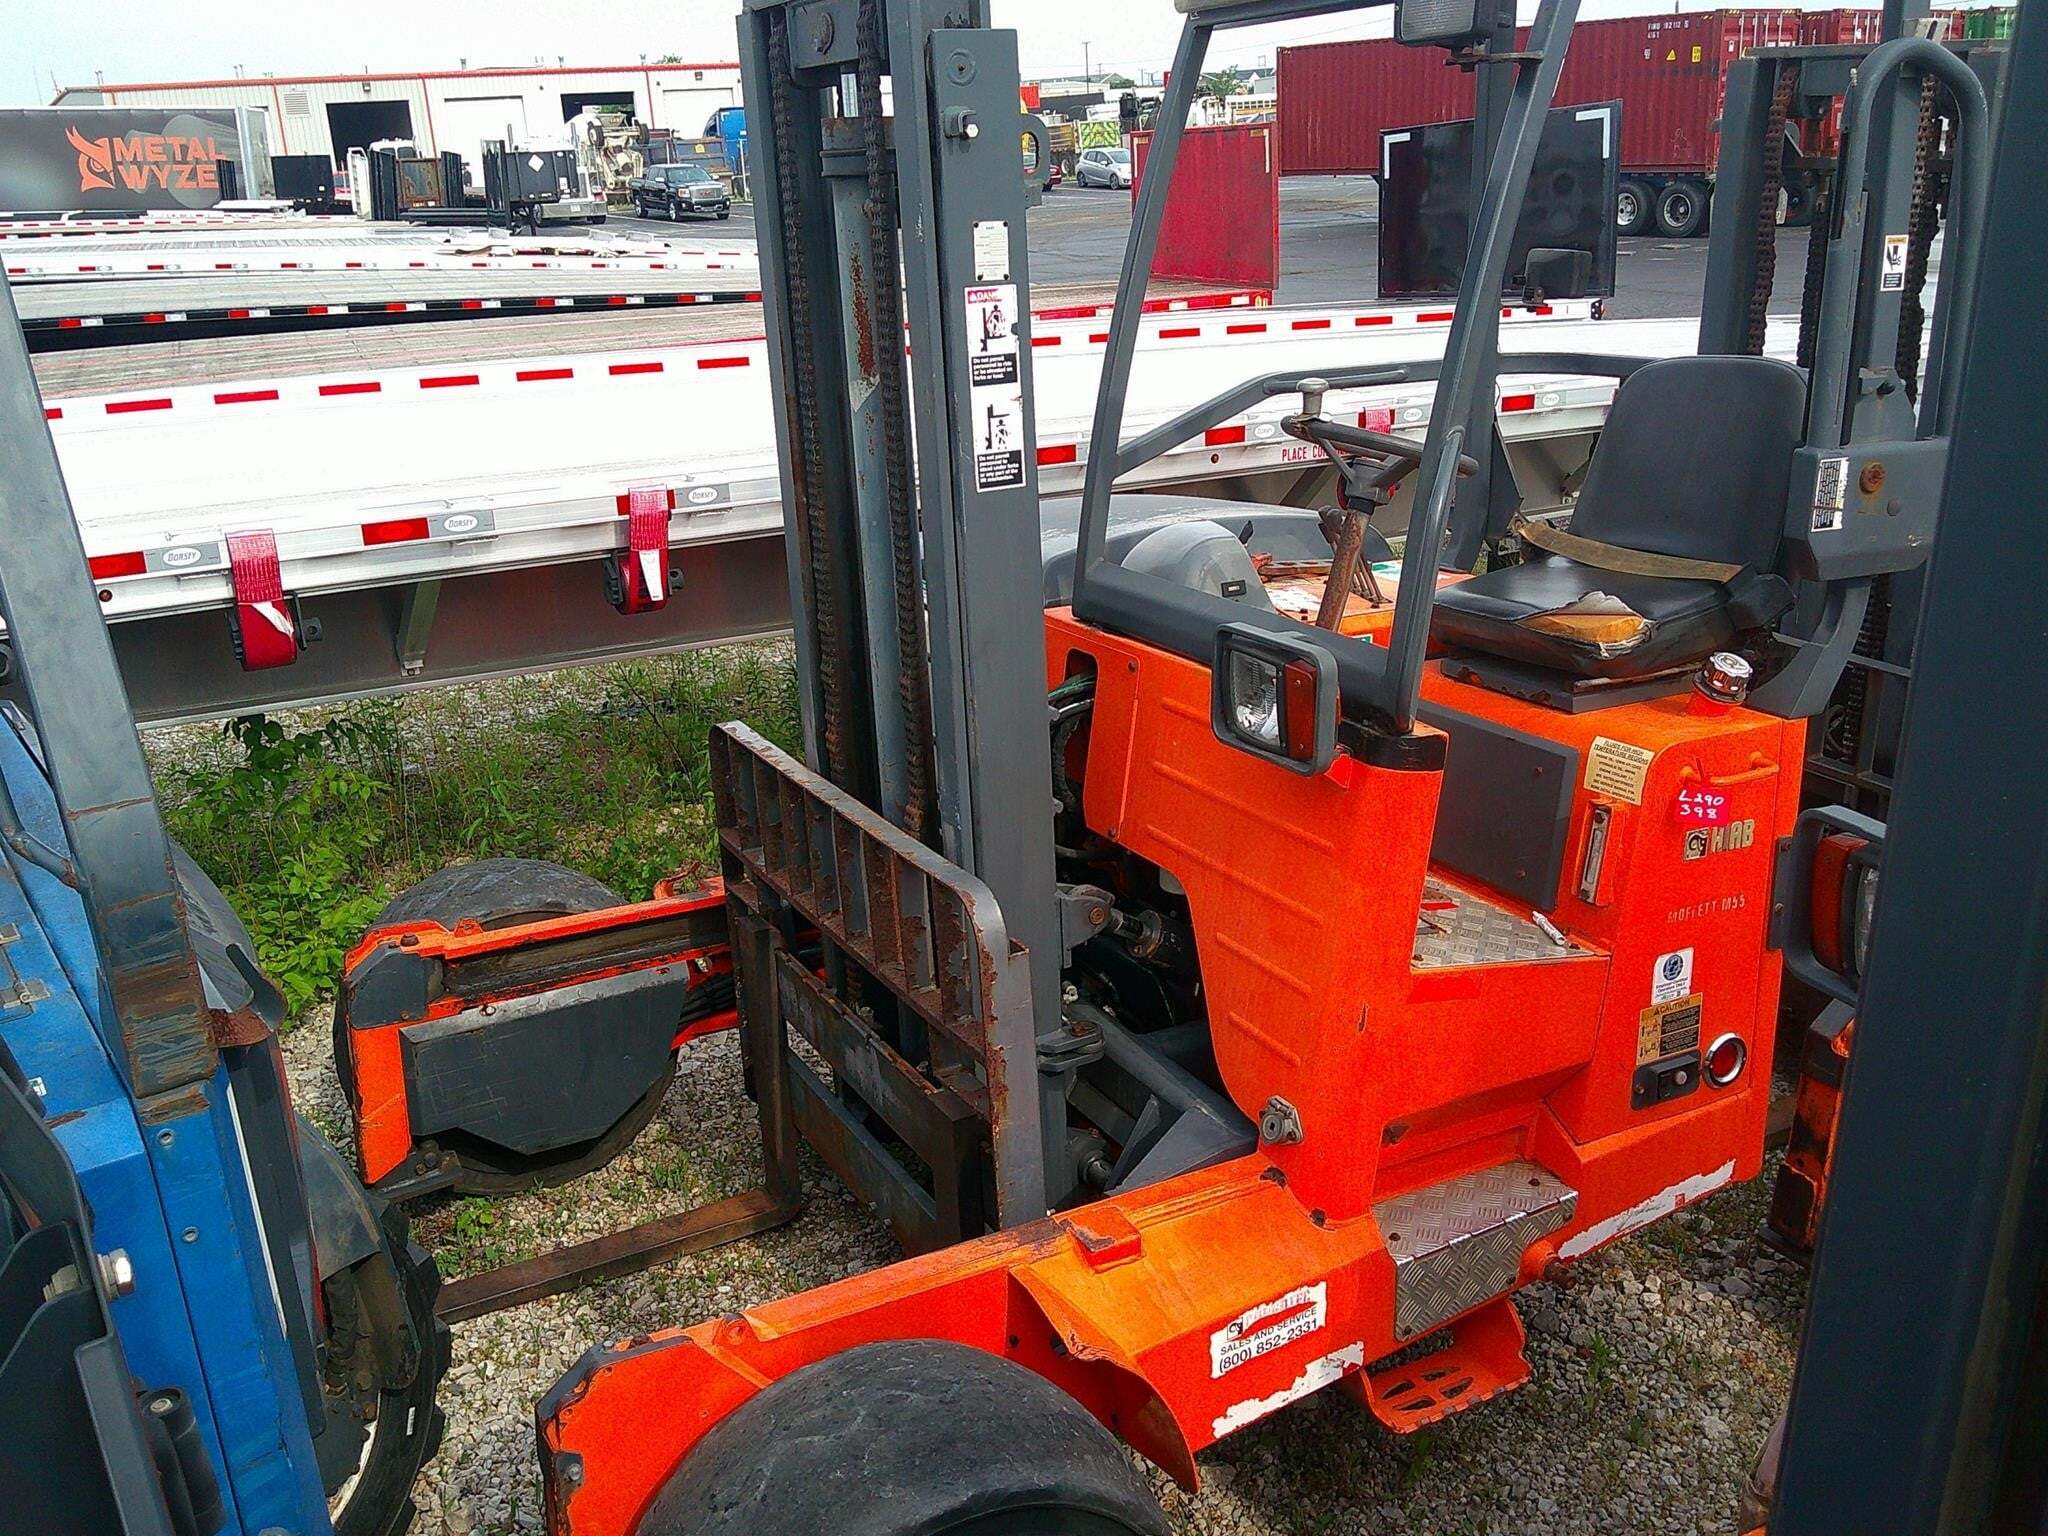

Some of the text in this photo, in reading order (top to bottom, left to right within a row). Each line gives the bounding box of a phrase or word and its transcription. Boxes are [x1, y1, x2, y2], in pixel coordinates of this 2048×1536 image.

[113, 137, 230, 162] METAL
[117, 164, 219, 189] WYZE
[1282, 446, 1307, 461] PLACE
[448, 519, 474, 528] DORSEY
[168, 552, 196, 562] DORSEY
[1594, 744, 1627, 758] TEMPERATURE
[1628, 754, 1649, 765] REGIONS
[1678, 790, 1724, 806] L290
[1680, 804, 1718, 818] 398
[1711, 818, 1755, 854] HIAB
[1667, 900, 1718, 924] MOFFETT
[1660, 998, 1690, 1014] CAUTION
[1220, 1338, 1252, 1356] SALES
[1254, 1326, 1274, 1341] AND
[1277, 1306, 1316, 1332] SERVICE
[1220, 1318, 1318, 1373] (800) 852-2331
